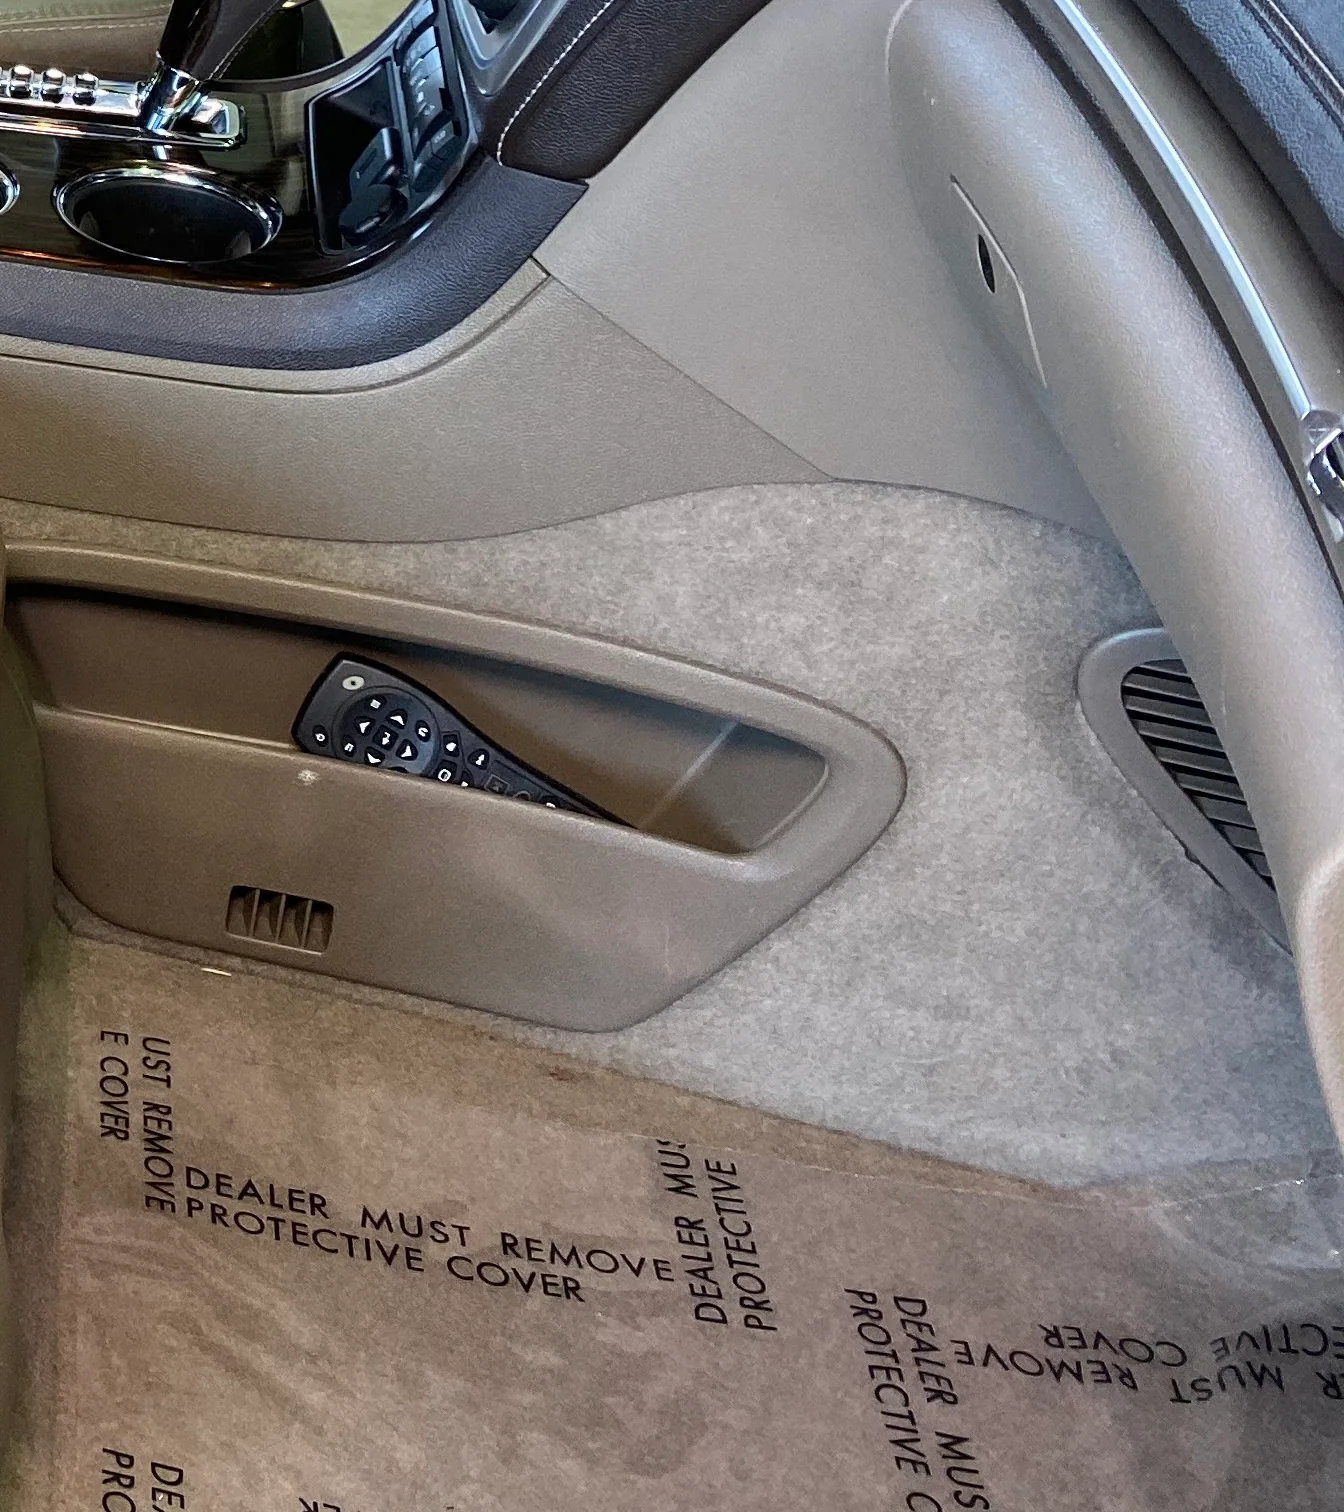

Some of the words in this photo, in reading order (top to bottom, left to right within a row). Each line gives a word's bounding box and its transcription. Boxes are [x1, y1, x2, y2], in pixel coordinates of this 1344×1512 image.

[98, 1055, 130, 1142] COVER
[141, 1100, 176, 1214] REMOVE
[185, 1165, 330, 1220] DEALER
[360, 1204, 471, 1248] MUST
[500, 1231, 675, 1282] REMOVE
[185, 1196, 425, 1273] PROTECTIVE
[446, 1255, 586, 1303] COVER
[674, 1215, 729, 1326] DEALER
[704, 1158, 778, 1332] PROTECTIVE
[843, 1287, 932, 1477] PROTECTIVE
[892, 1295, 959, 1406] DEALER
[949, 1339, 1140, 1393] REMOVE
[1038, 1323, 1188, 1368] COVER
[1169, 1360, 1285, 1405] MUST
